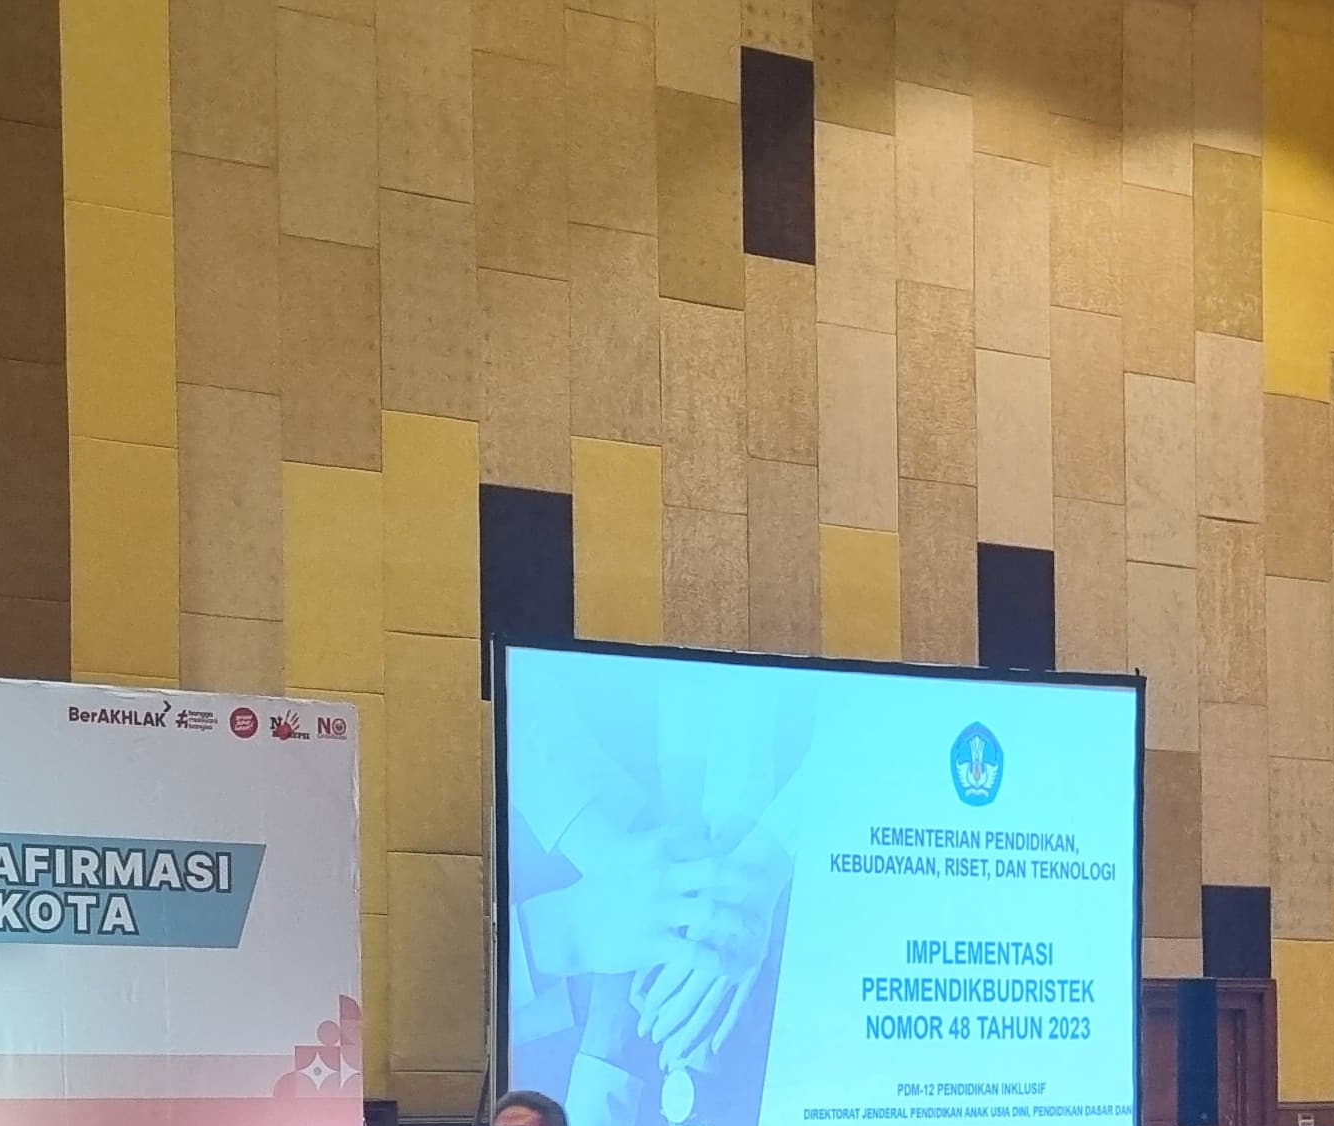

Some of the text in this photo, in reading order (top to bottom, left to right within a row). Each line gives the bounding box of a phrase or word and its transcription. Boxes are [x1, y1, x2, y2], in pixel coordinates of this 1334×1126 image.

[68, 706, 167, 728] BerAKHLAK
[870, 826, 1080, 855] KEMENTERIAN PENDIDIKAN,
[830, 853, 1116, 881] KEBUDAYAAN, RISET, DAN TEKNOLOGI
[906, 939, 1054, 966] IMPLEMENTASI
[862, 976, 1095, 1003] PERMENDIKBUDRISTEK
[865, 1014, 1091, 1040] NOMOR 48 TAHUN 2023
[897, 1081, 1047, 1097] PDM-12 PENDIDIKAN INKLUSIF
[803, 1104, 1132, 1120] DIREKTORAT JENDERAL PENDIDIKAN ANAK USIA DINI, PENDIDIKAN DASAR DAN
